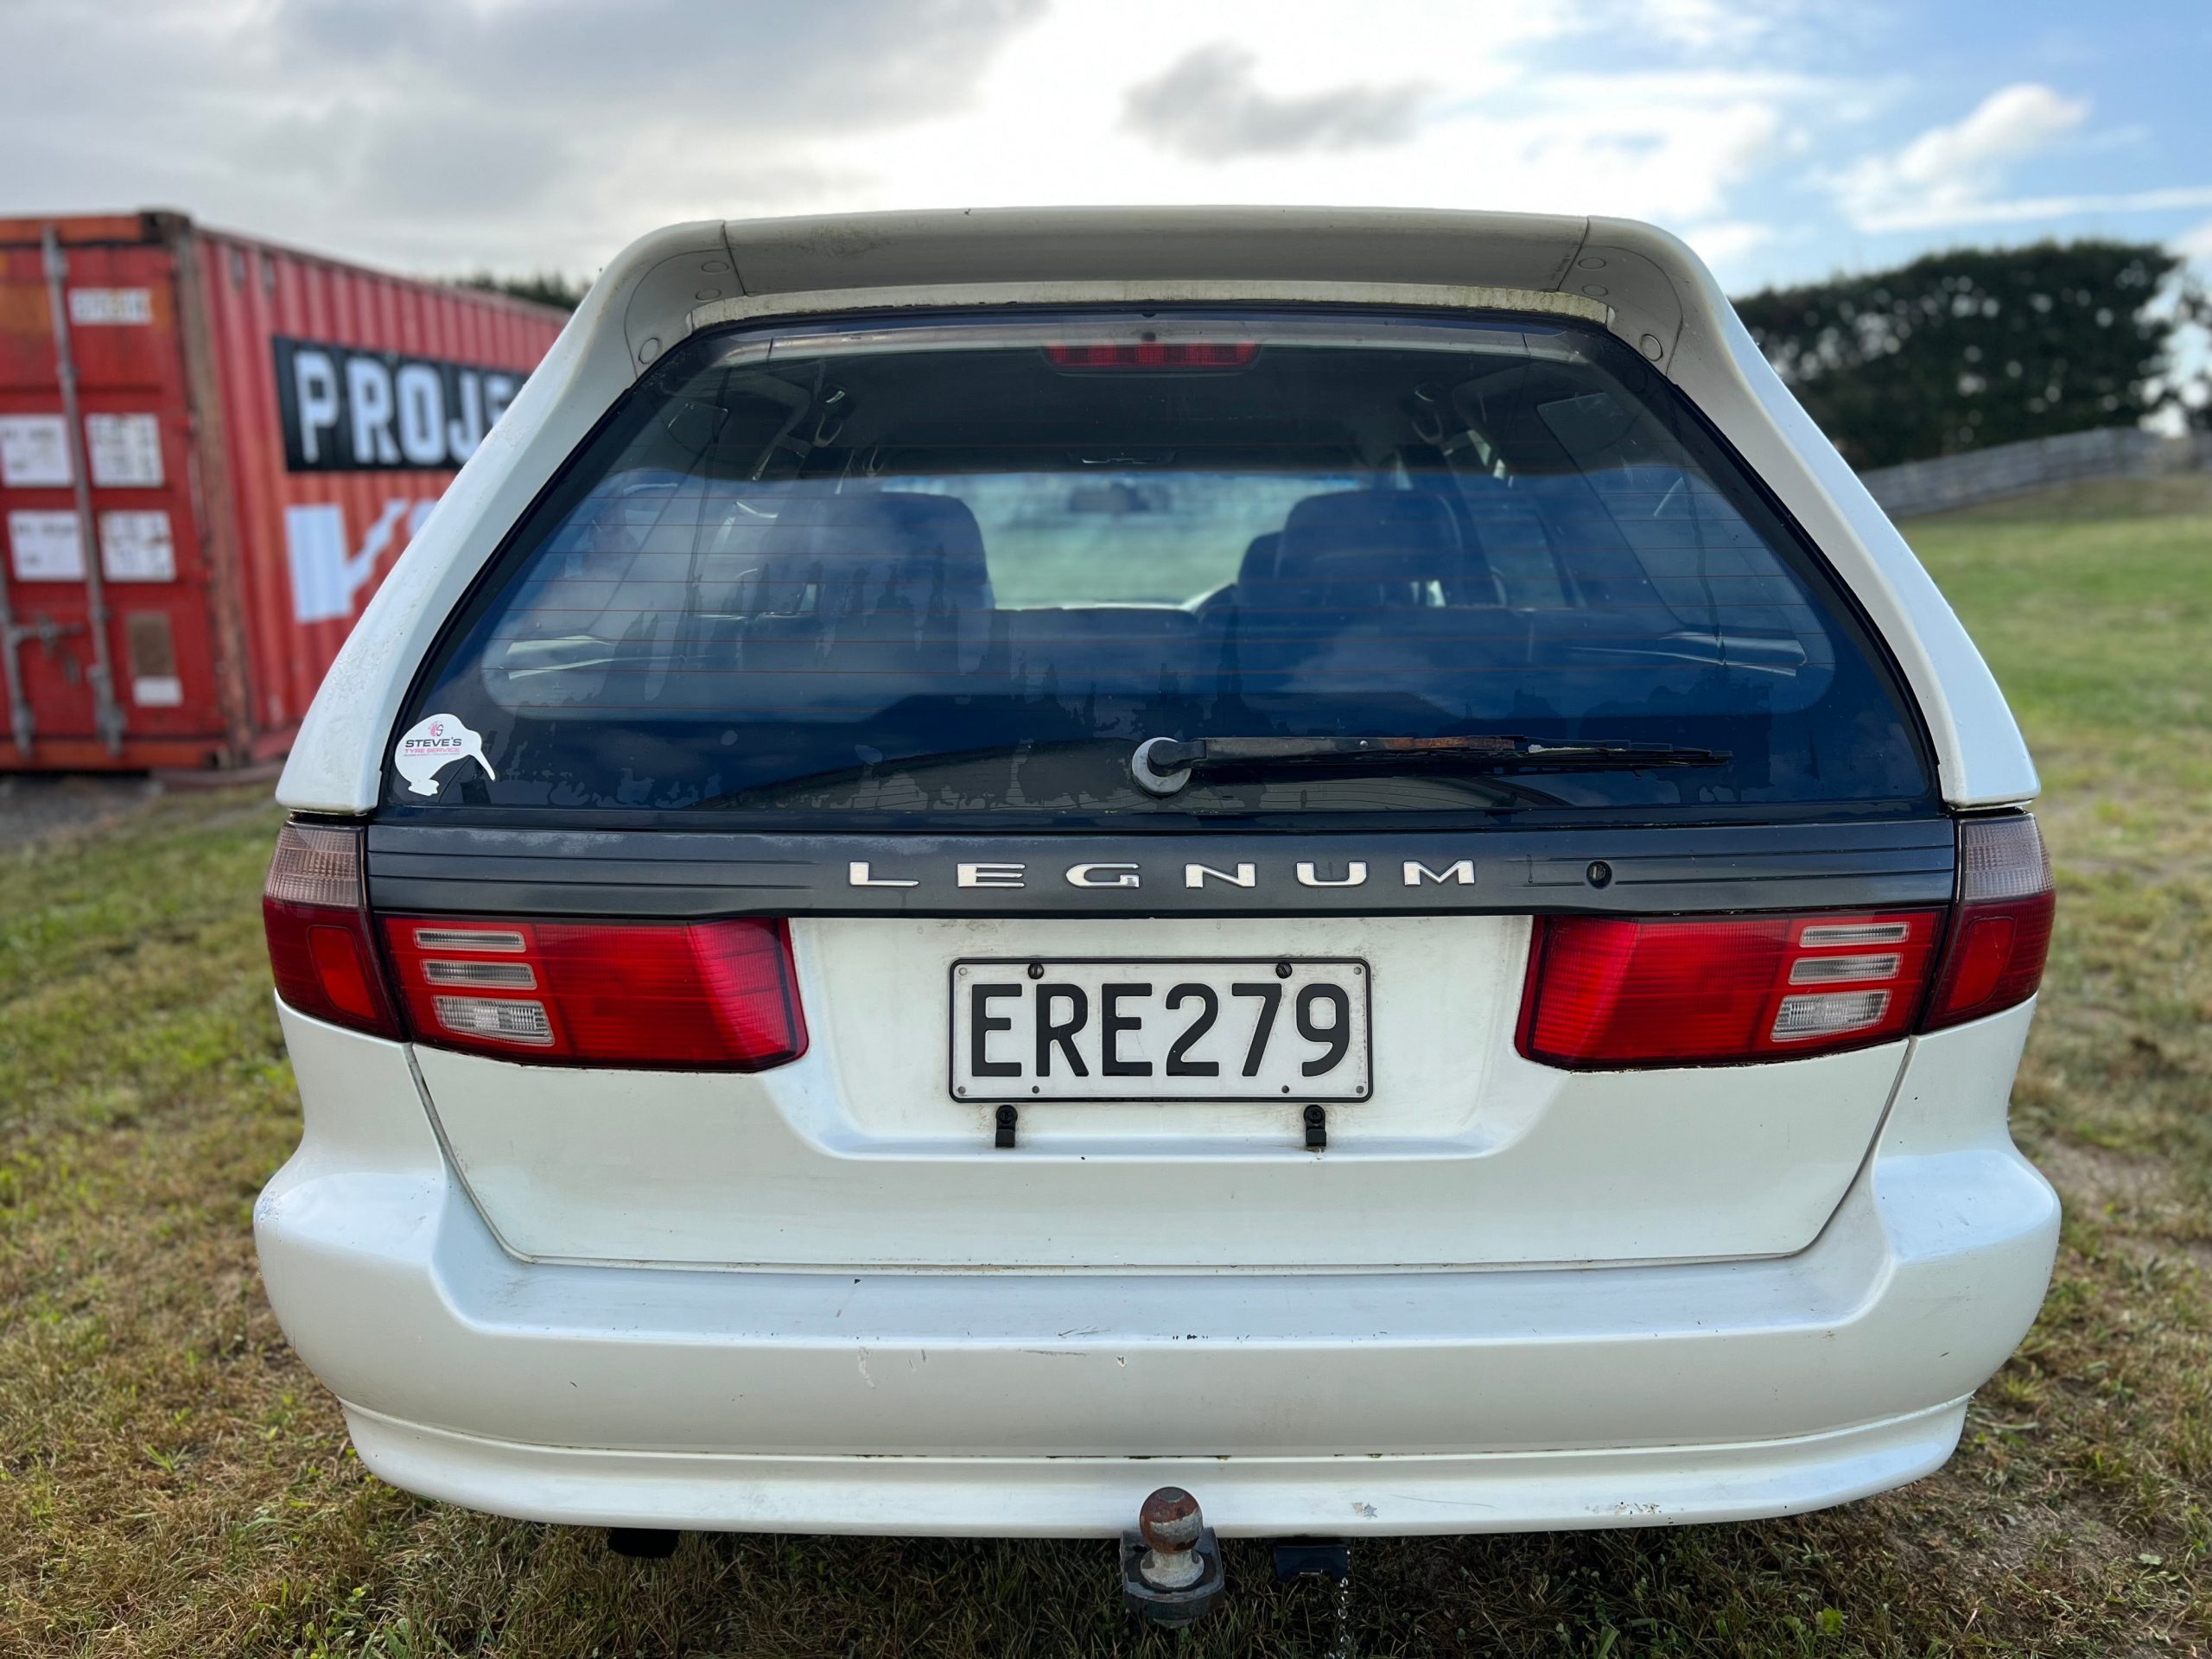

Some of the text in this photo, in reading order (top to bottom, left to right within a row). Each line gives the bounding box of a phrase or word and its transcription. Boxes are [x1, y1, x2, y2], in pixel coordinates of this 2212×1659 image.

[405, 737, 462, 747] STEVE'S
[849, 860, 1476, 889] LEGNUM
[970, 982, 1351, 1077] ERE279
